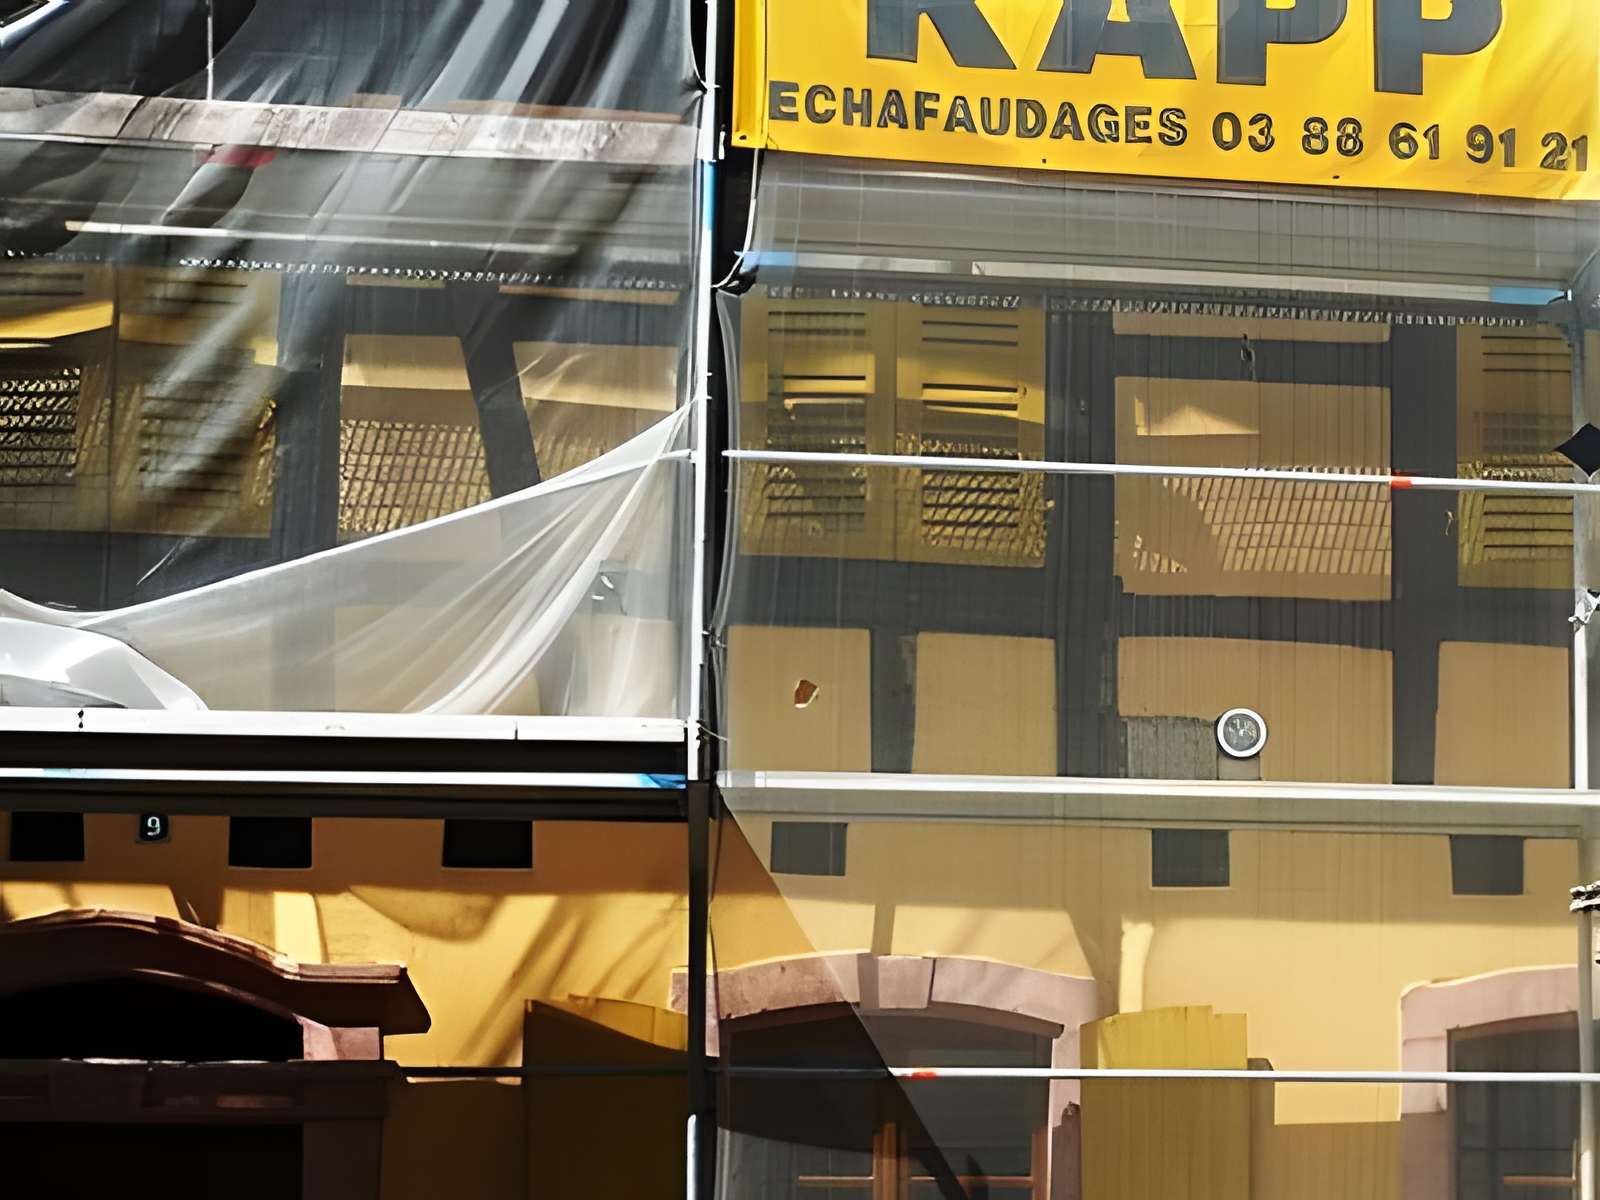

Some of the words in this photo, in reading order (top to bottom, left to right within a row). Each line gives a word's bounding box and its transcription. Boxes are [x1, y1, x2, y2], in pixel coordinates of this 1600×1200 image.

[866, 0, 1502, 95] KAPP
[769, 80, 1188, 146] ECHAFAUDAGES
[1212, 111, 1275, 153] 03
[1302, 116, 1364, 157] 88
[1389, 122, 1440, 160] 61
[1466, 124, 1516, 168] 91
[1540, 132, 1588, 172] 21
[147, 816, 160, 836] 9
